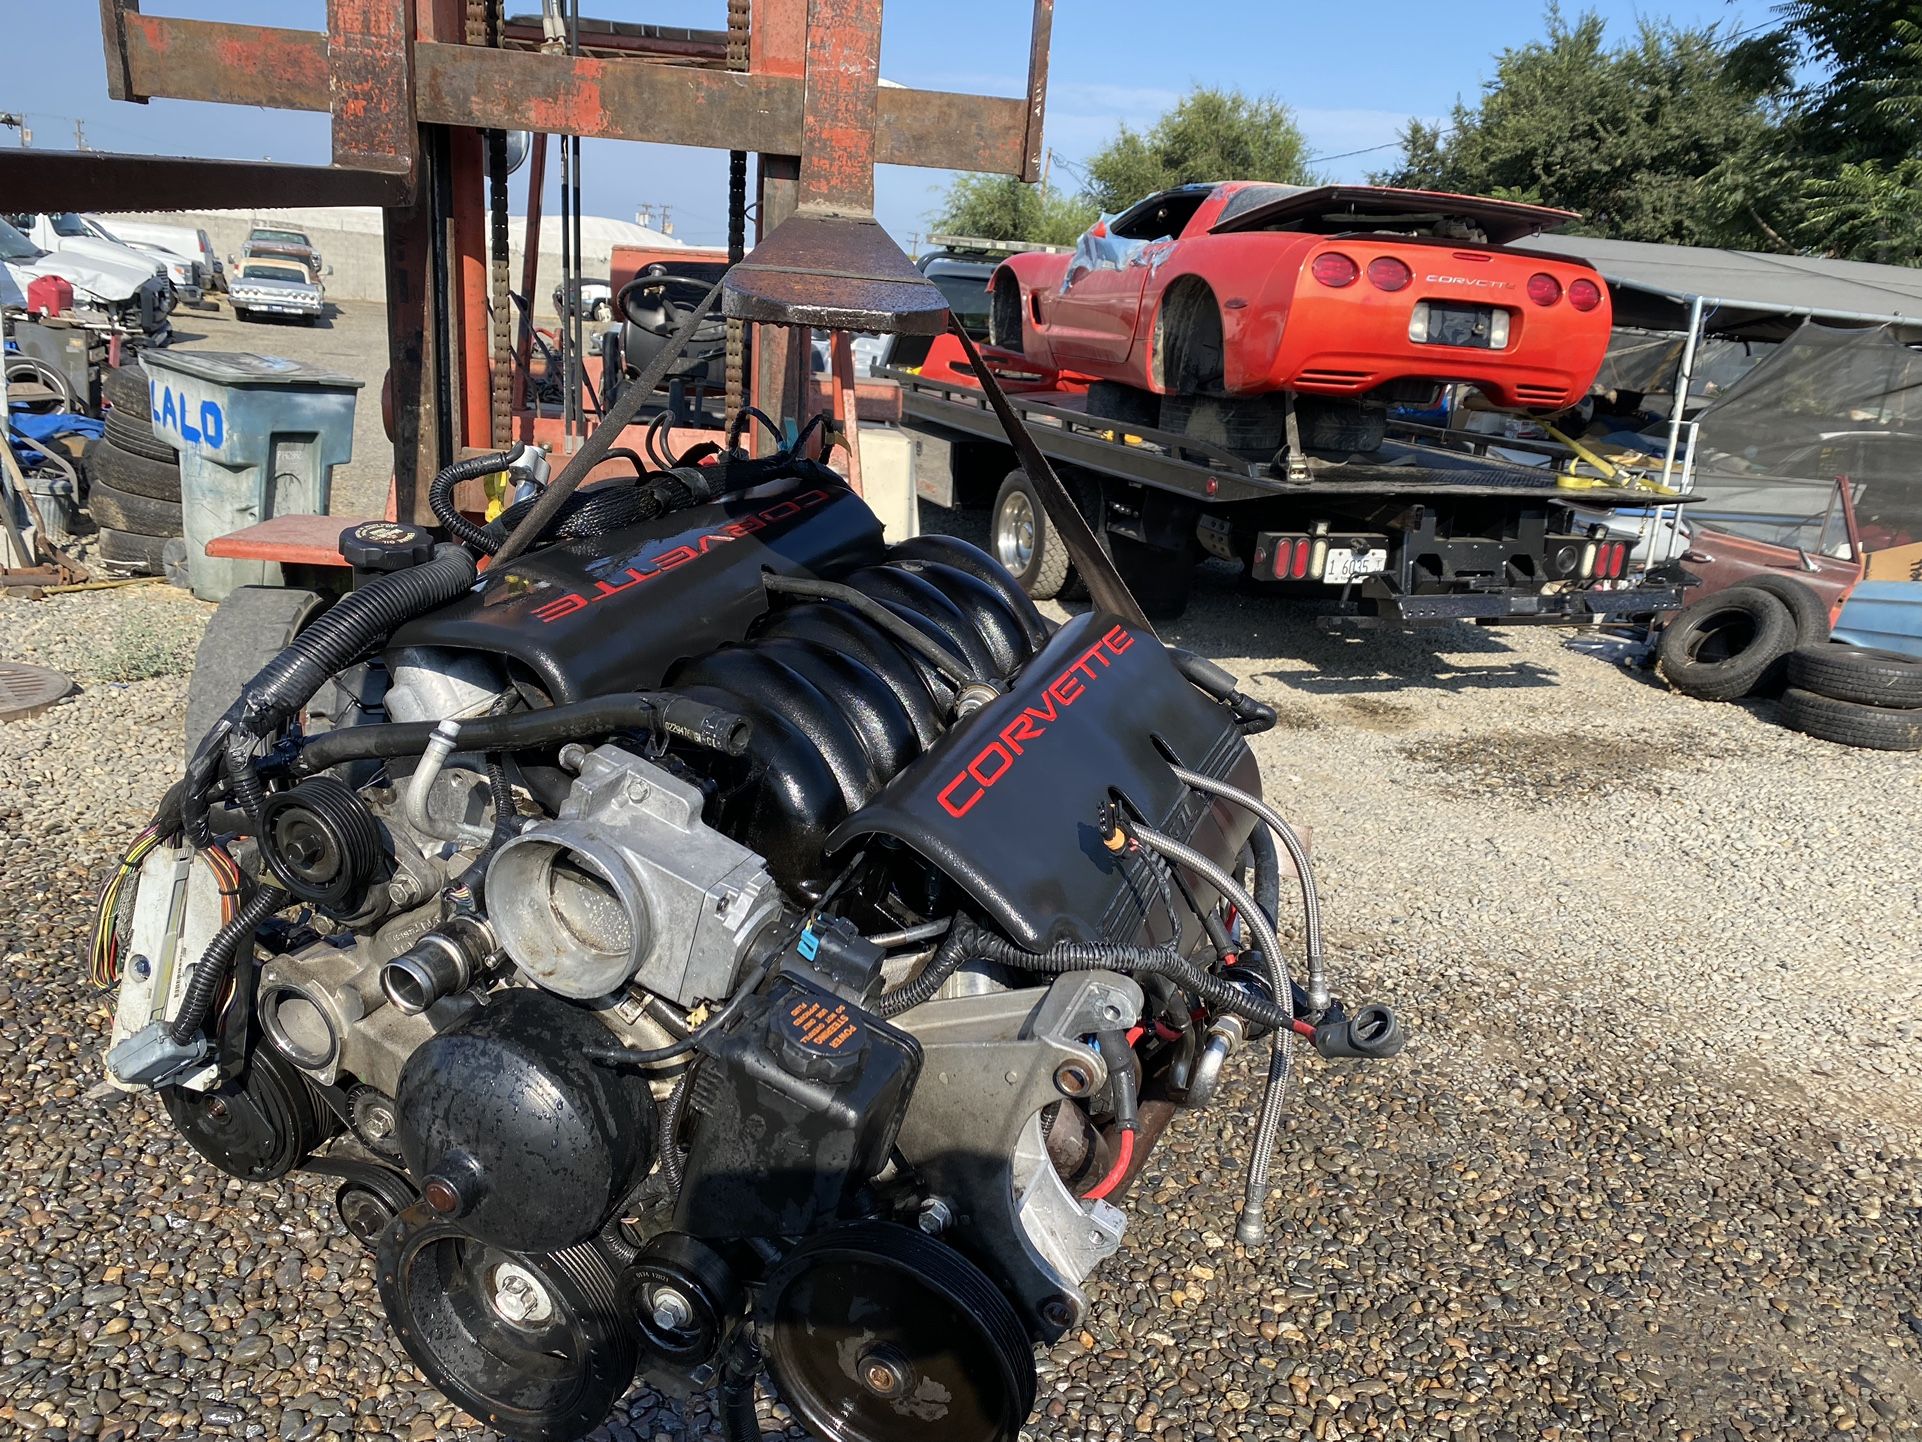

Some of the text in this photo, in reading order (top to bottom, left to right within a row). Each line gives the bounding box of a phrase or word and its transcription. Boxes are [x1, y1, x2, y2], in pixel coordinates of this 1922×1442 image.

[1425, 275, 1516, 289] CORVETTE
[150, 379, 224, 449] LALO
[530, 489, 830, 623] CORVETTE
[1341, 559, 1370, 576] 6035
[937, 624, 1136, 818] CORVETTE
[790, 1002, 807, 1016] FLUID
[792, 1002, 820, 1027] APPROVED
[802, 1008, 829, 1031] USE ONLY
[800, 1004, 845, 1044] DO NOT OVERFILL
[812, 1014, 849, 1045] STEERING
[829, 1024, 857, 1048] POWER
